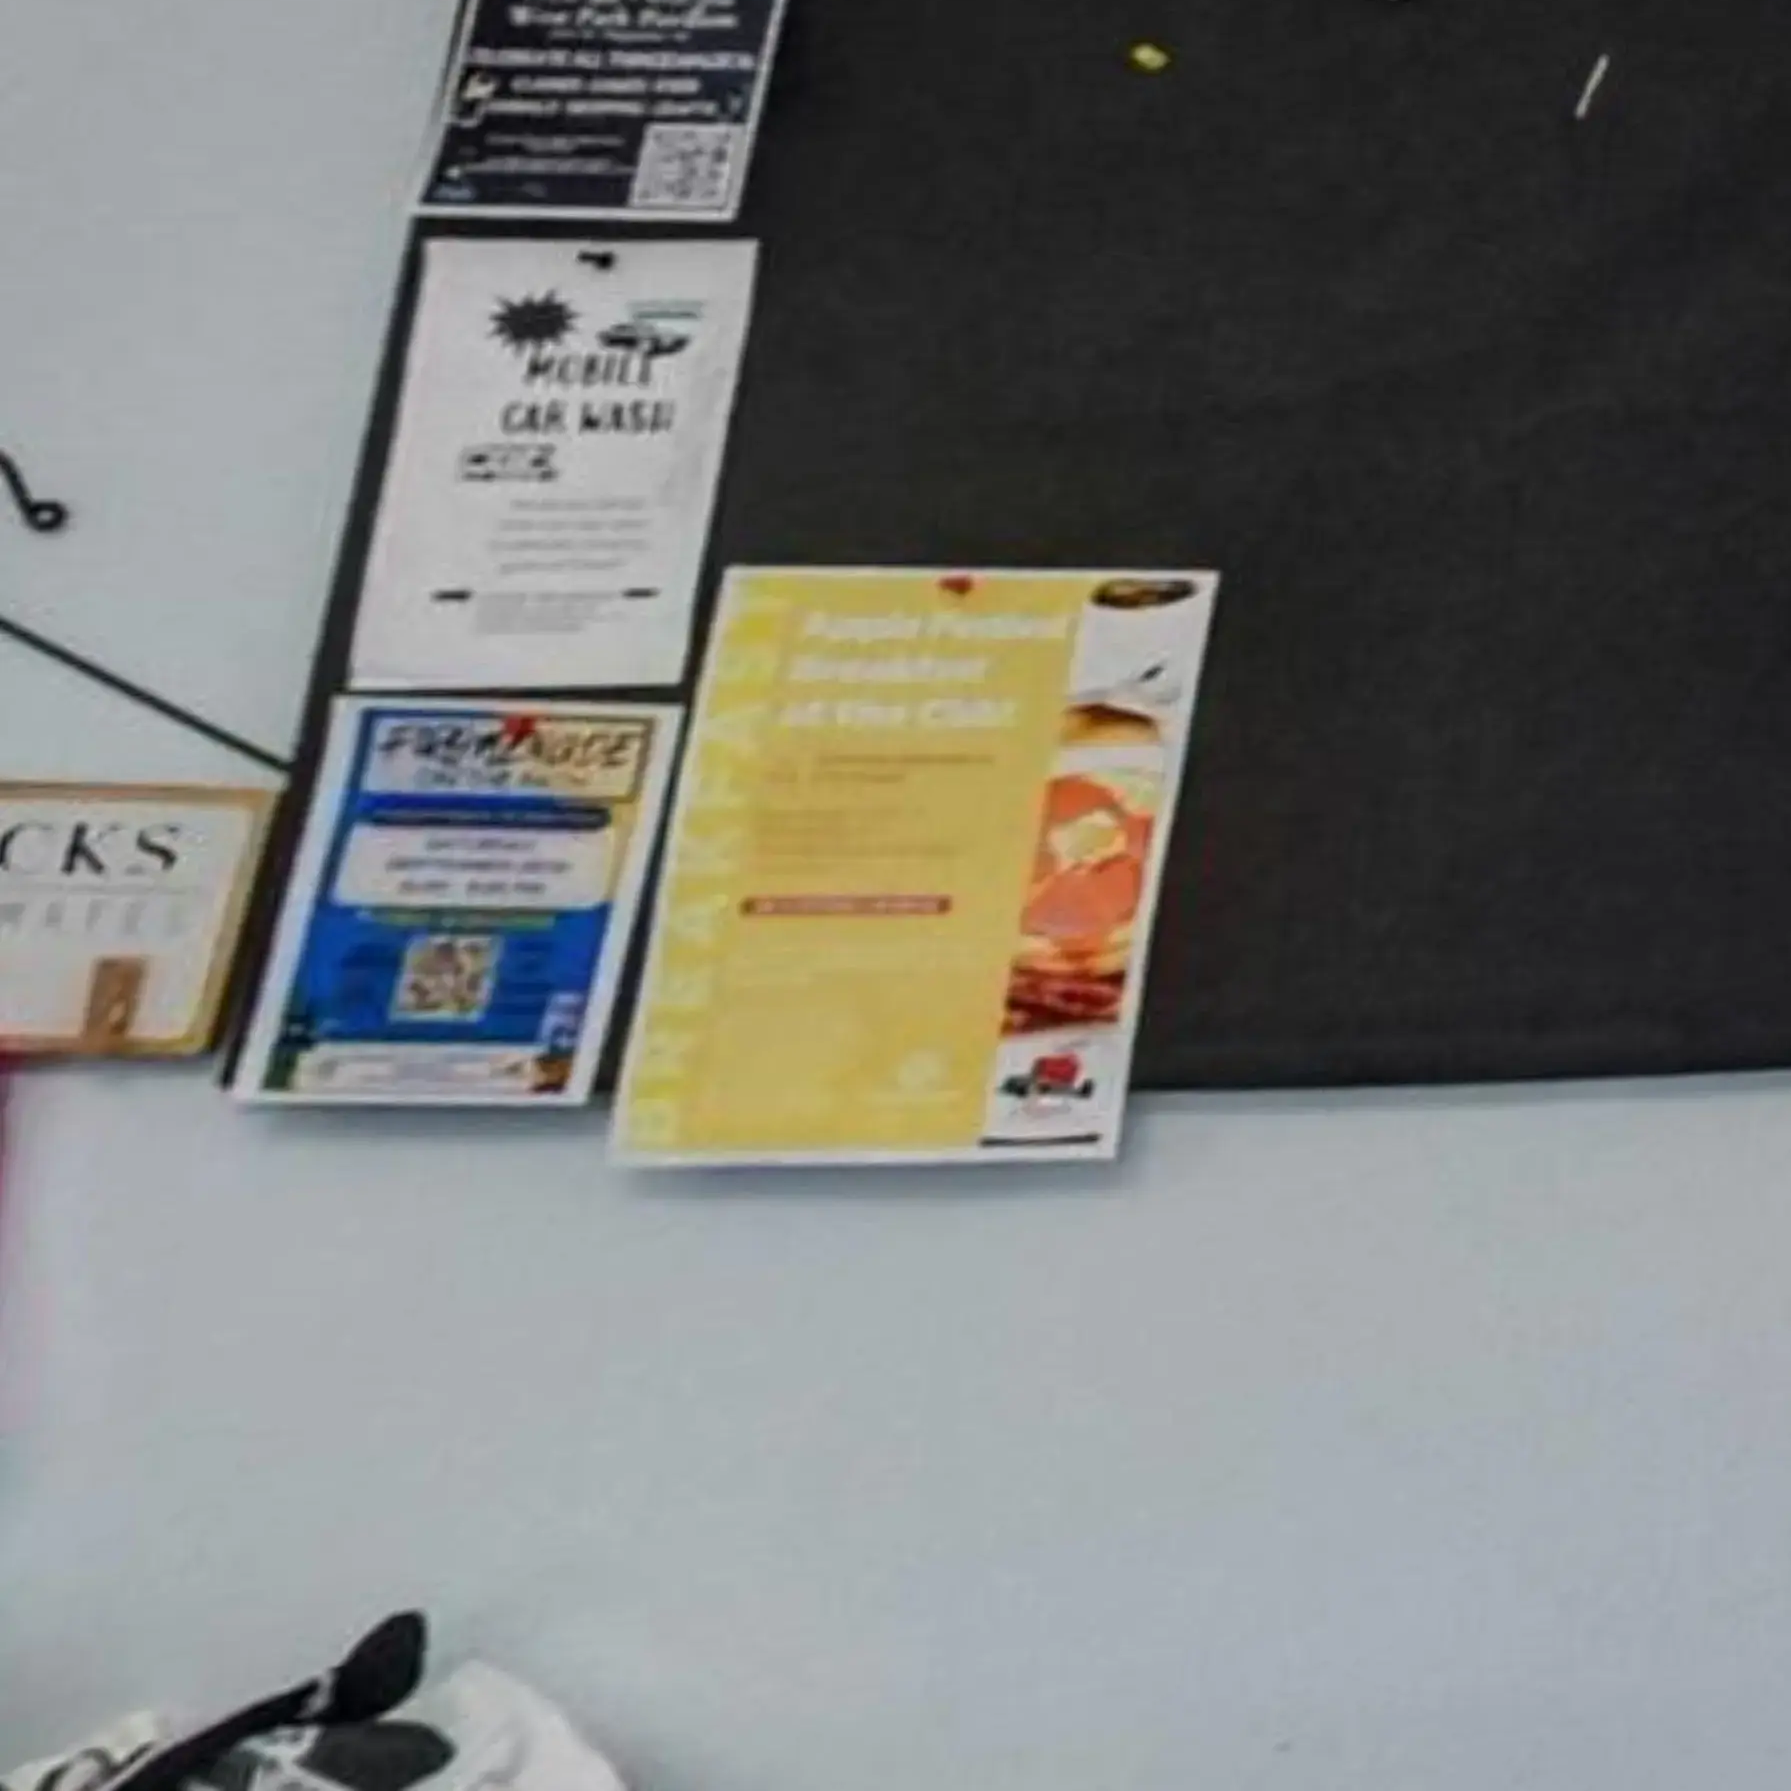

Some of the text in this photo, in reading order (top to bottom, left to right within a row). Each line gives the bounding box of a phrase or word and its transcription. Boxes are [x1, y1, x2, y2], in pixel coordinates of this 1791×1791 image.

[575, 5, 630, 28] Park
[522, 352, 657, 388] MOBILE
[500, 399, 676, 436] CAR WASH
